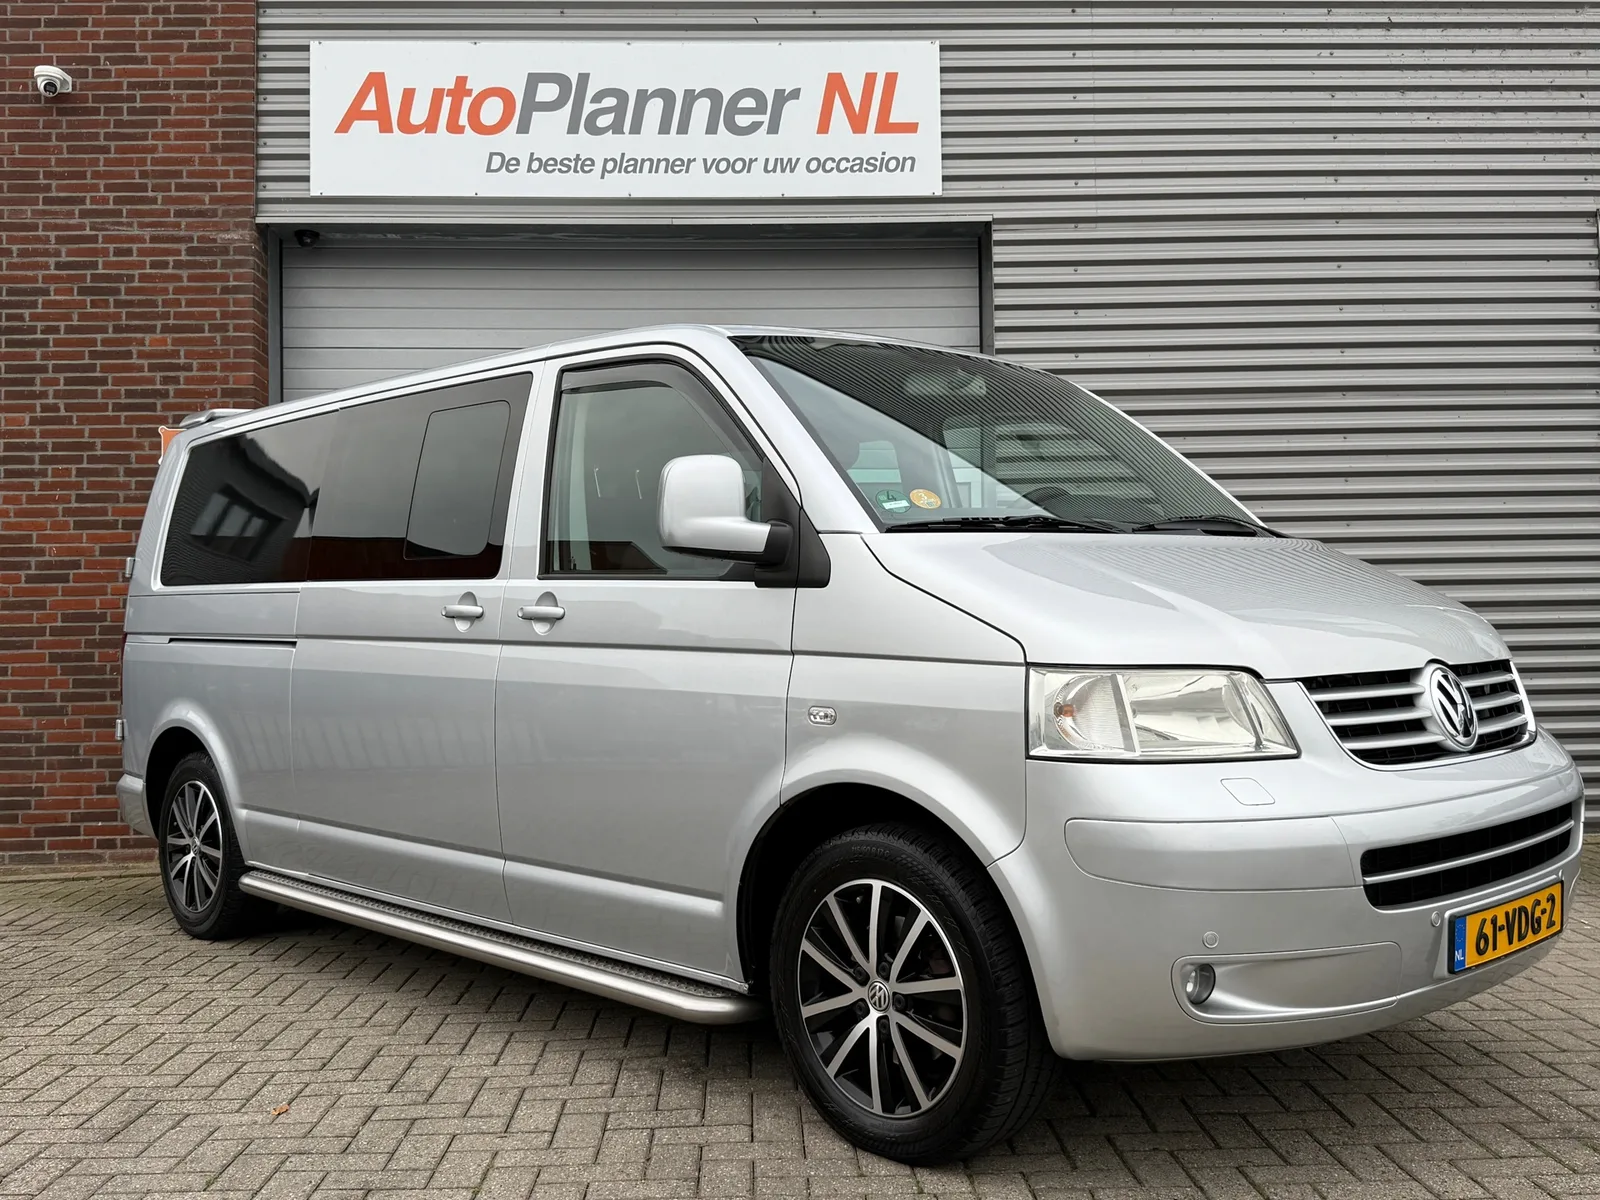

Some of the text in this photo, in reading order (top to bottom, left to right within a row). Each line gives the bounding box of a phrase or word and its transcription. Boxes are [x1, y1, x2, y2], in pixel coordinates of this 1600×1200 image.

[333, 71, 920, 136] AutoPlanner NL
[486, 151, 917, 180] De beste planner voor uw occasion
[1475, 893, 1556, 956] 61-VDG-2
[1455, 949, 1465, 961] NL
